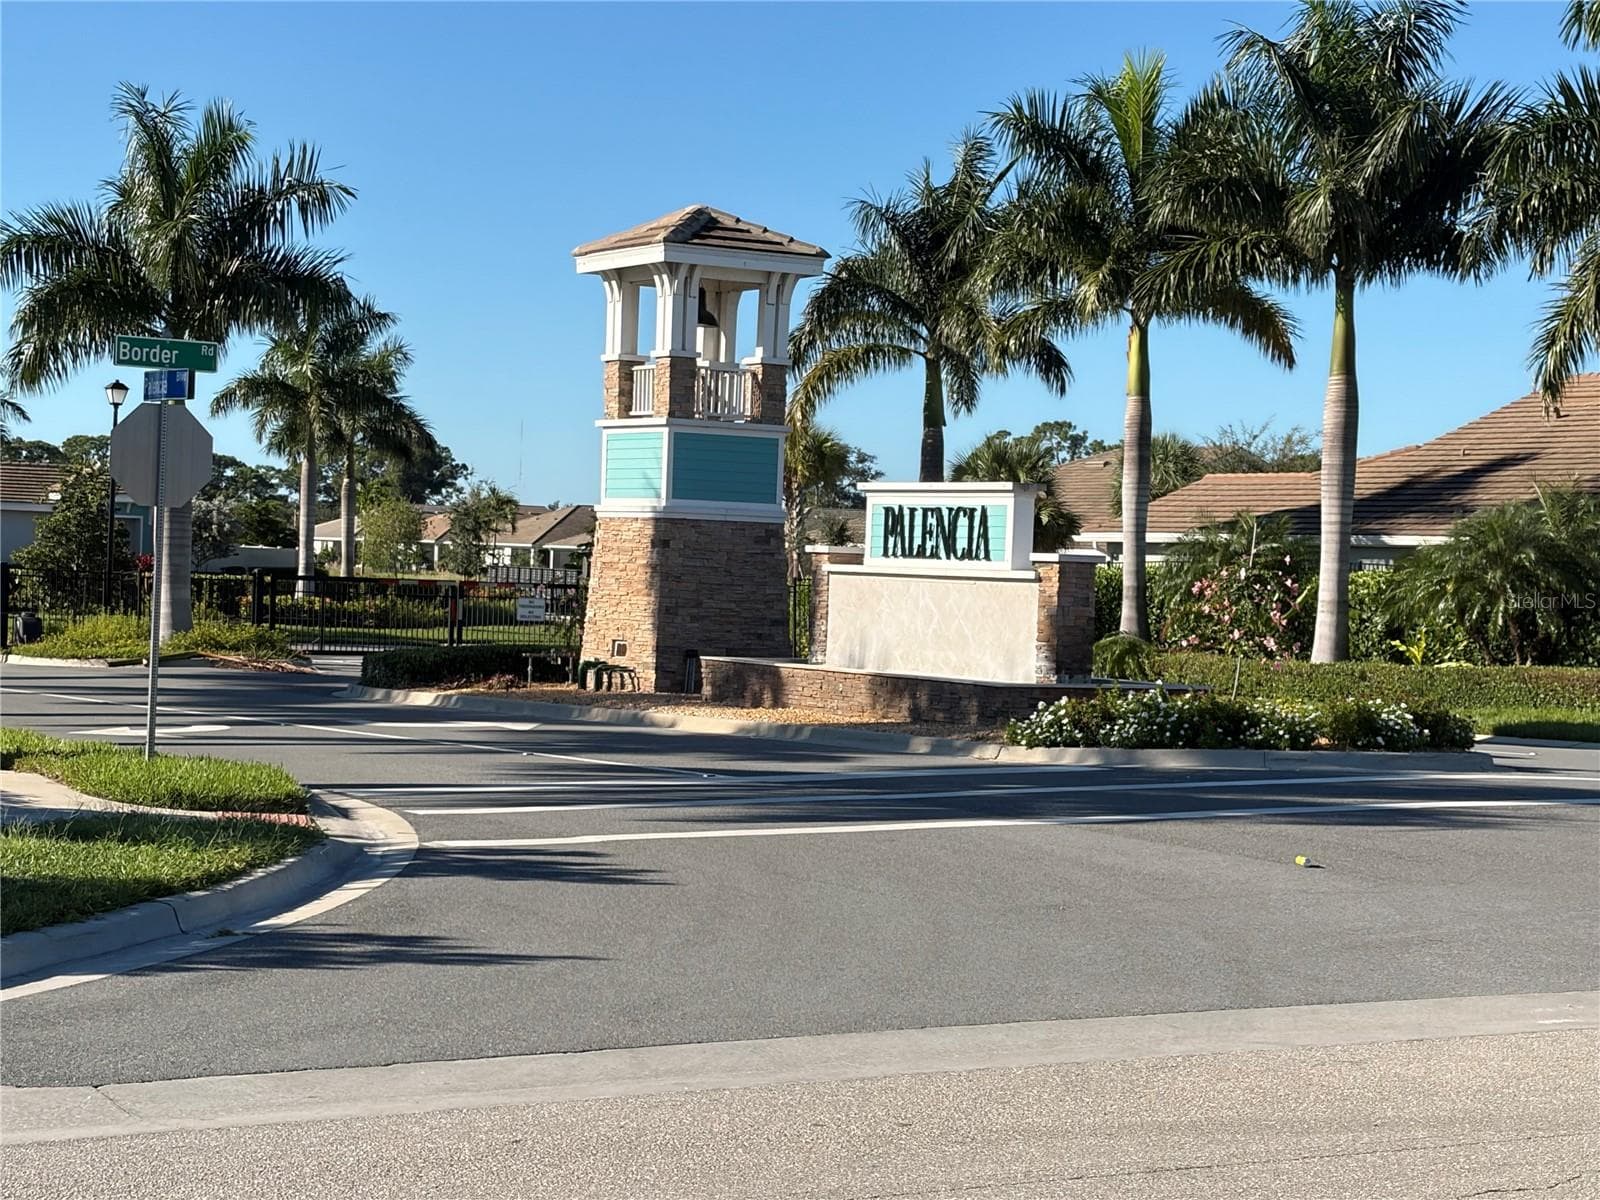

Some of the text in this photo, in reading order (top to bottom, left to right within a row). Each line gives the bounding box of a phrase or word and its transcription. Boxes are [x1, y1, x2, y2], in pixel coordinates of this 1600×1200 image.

[119, 341, 214, 364] Border Rd
[882, 504, 992, 562] PALENCIA
